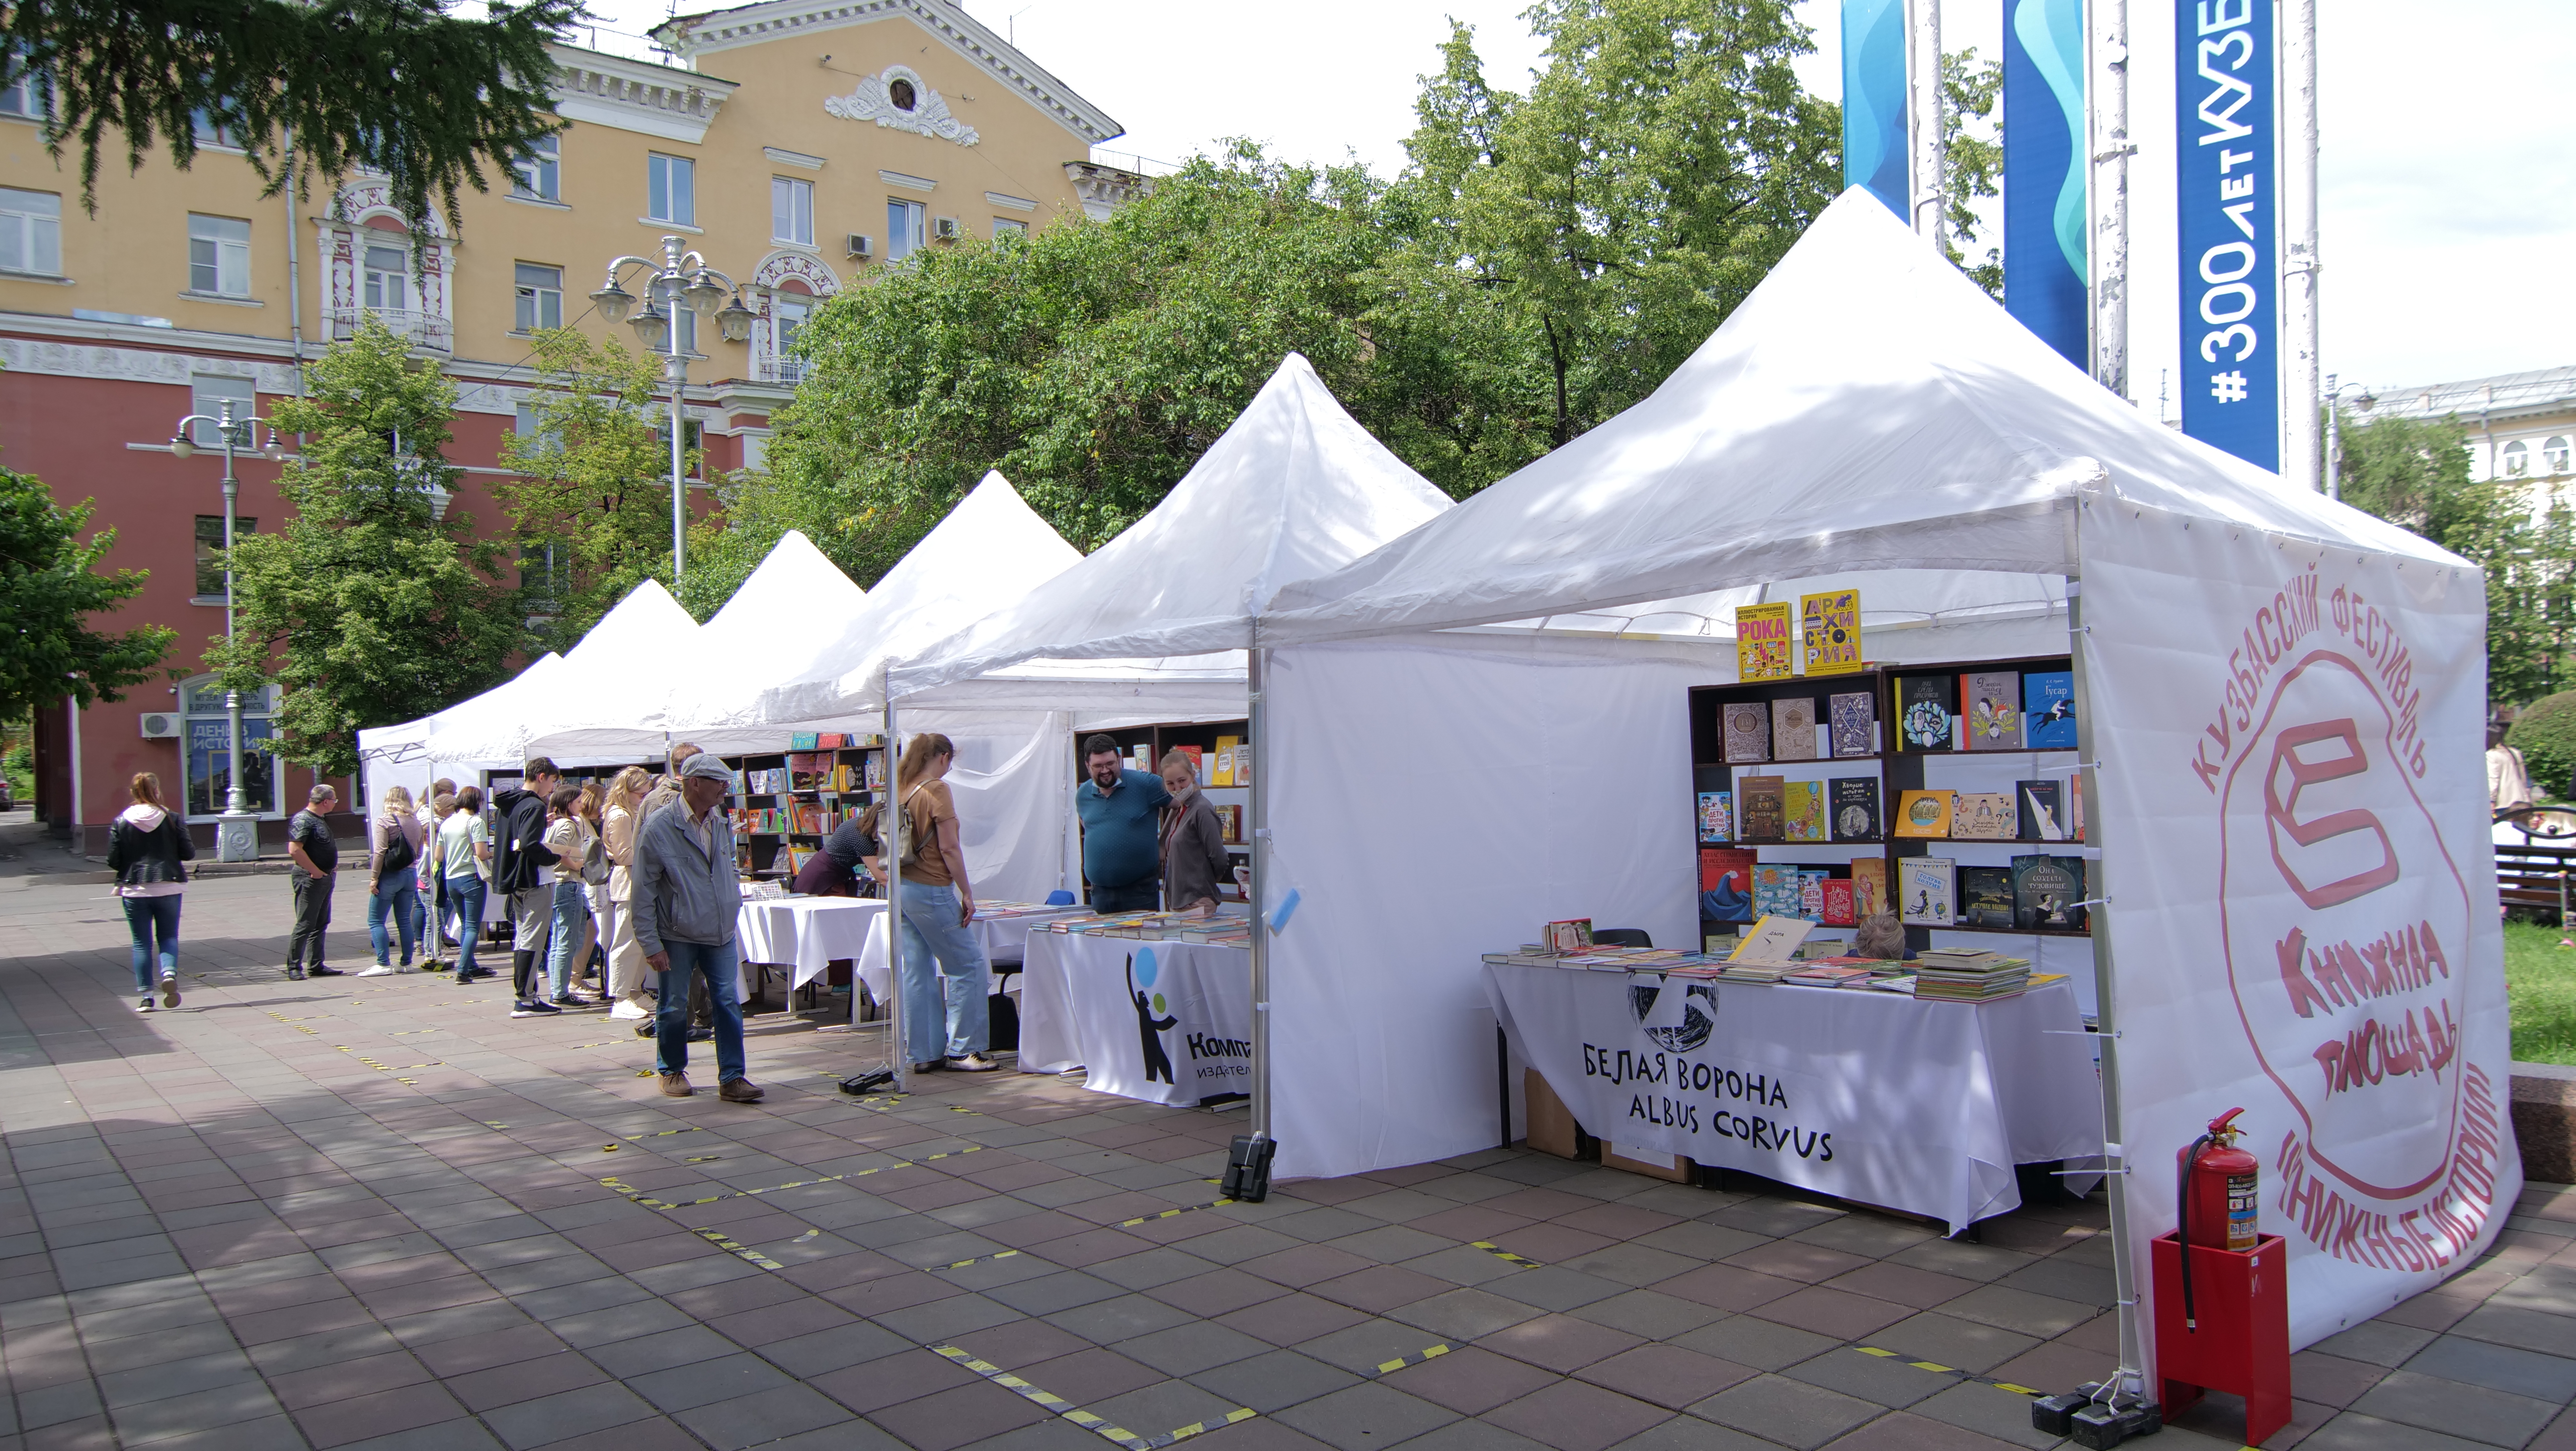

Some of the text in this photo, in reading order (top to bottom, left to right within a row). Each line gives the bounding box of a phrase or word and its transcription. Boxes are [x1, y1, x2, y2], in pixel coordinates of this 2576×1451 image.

[1738, 606, 1784, 615] ИЛЛЮСТРИРОВАННАЯ
[1738, 618, 1787, 641] РОКА
[2191, 562, 2426, 795] КУЗБАССКИЙ ФЕСТИВАЛЬ
[2045, 685, 2067, 698] Гусар
[1917, 877, 1941, 889] КОЛУМБ
[1920, 873, 1941, 885] ГОЛУБЬ
[2312, 997, 2456, 1101] ПЛОЩАДЬ
[1583, 1042, 1788, 1110] БЕЛАЯ ВОРОНА
[1629, 1093, 1833, 1162] ALBUS CORVUS
